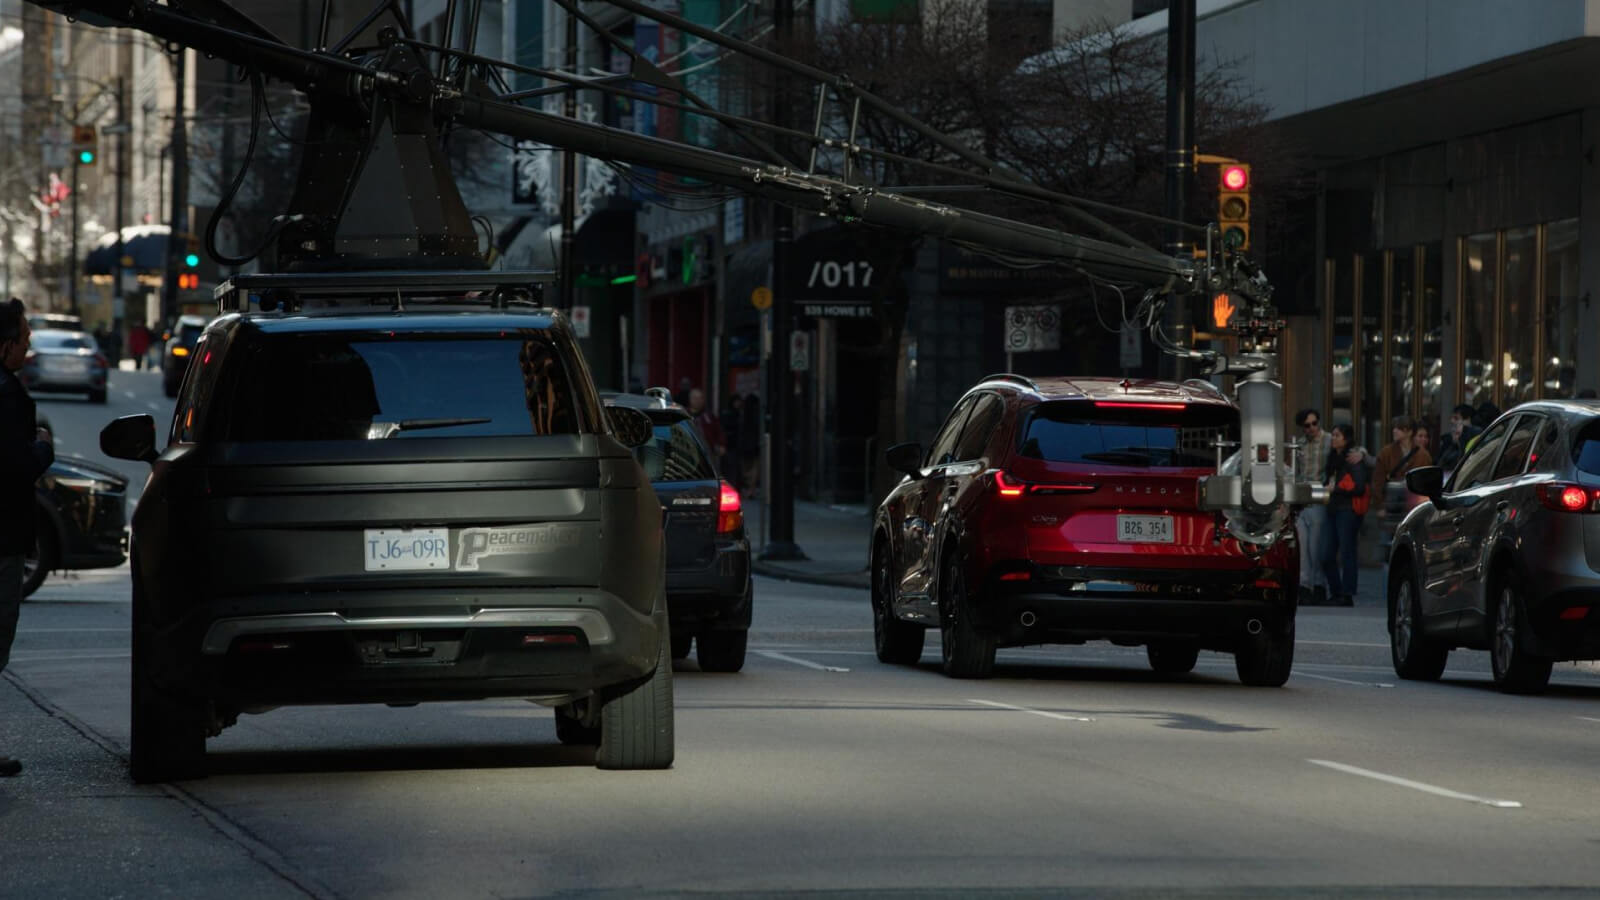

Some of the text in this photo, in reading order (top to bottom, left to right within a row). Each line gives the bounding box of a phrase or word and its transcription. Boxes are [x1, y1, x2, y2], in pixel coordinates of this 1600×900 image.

[824, 305, 856, 317] HOWE
[1115, 486, 1181, 494] MAZDA
[1124, 521, 1167, 534] B26 354
